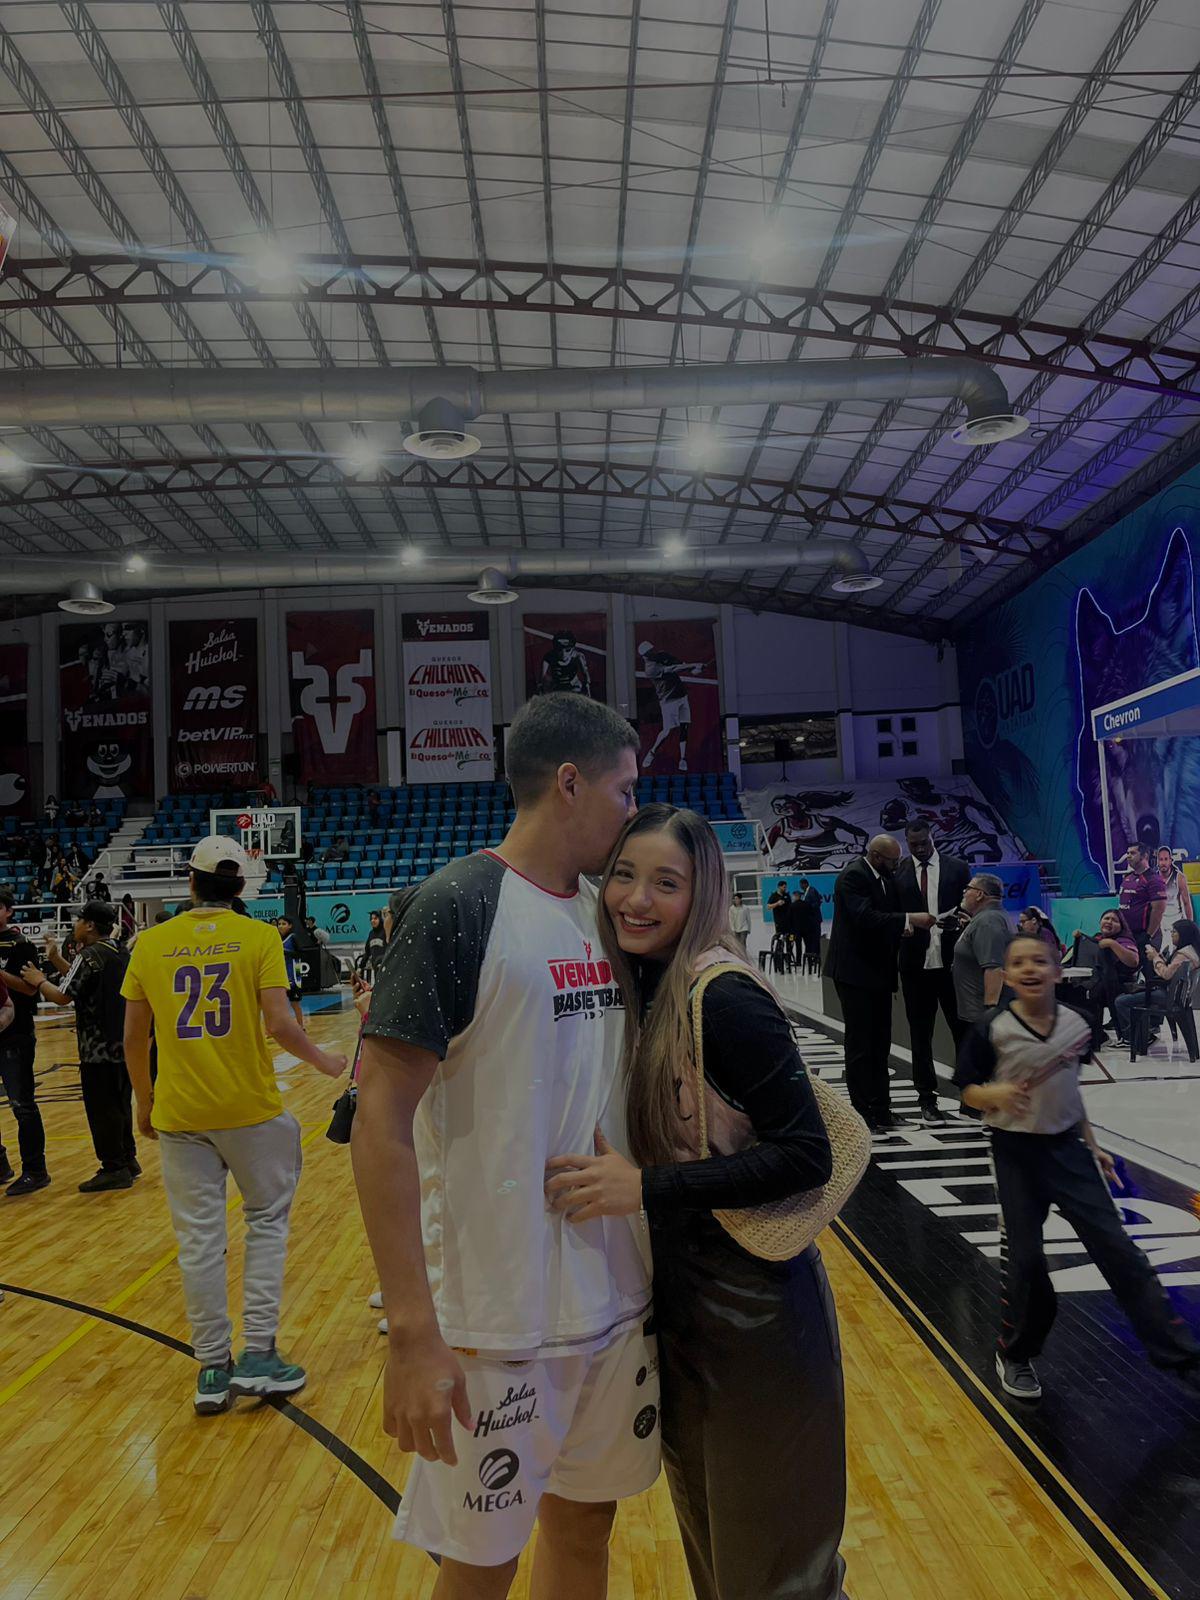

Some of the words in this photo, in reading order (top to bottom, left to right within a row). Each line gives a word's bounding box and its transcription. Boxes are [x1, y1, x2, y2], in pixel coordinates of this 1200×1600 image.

[416, 619, 474, 636] VENADOS
[202, 629, 237, 650] Salsa
[185, 640, 240, 674] Huichol
[408, 663, 487, 685] CHILCHOTA
[416, 688, 446, 698] Queso
[64, 706, 149, 733] VENADOS
[1103, 706, 1141, 731] Chevron
[410, 727, 489, 748] CHILCHOTA
[417, 752, 447, 762] Queso
[252, 814, 276, 825] UAD
[326, 924, 358, 934] MEGA
[162, 941, 242, 958] JAMES
[173, 961, 232, 1040] 23
[496, 1382, 537, 1410] Salsa
[473, 1398, 537, 1439] Huichol
[462, 1489, 523, 1513] MEGA
